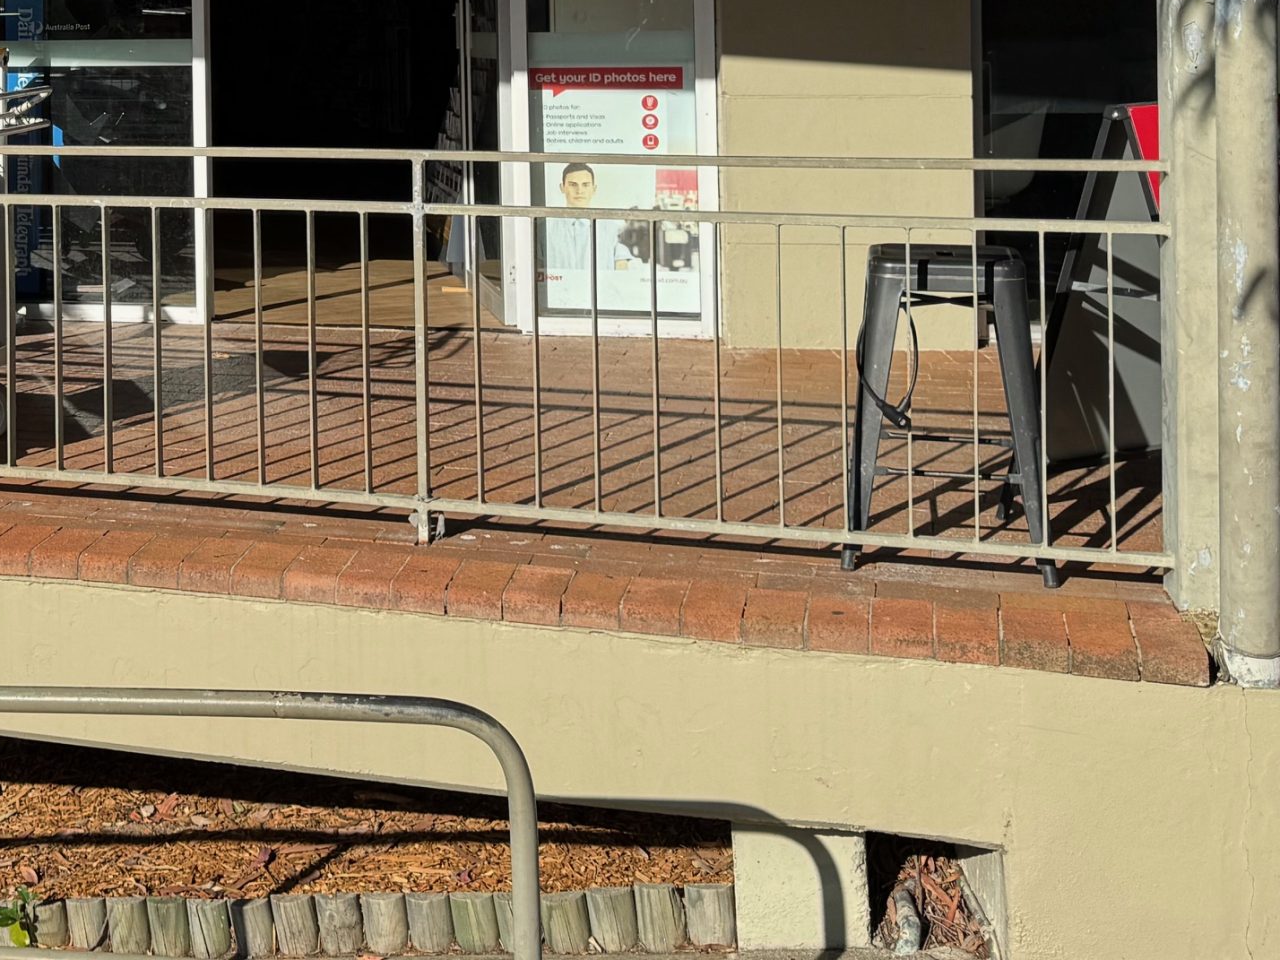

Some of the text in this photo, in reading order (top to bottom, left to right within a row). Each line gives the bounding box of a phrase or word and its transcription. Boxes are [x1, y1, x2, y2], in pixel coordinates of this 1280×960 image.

[45, 23, 91, 32] Australia Post
[535, 72, 677, 84] Get your ID photos here
